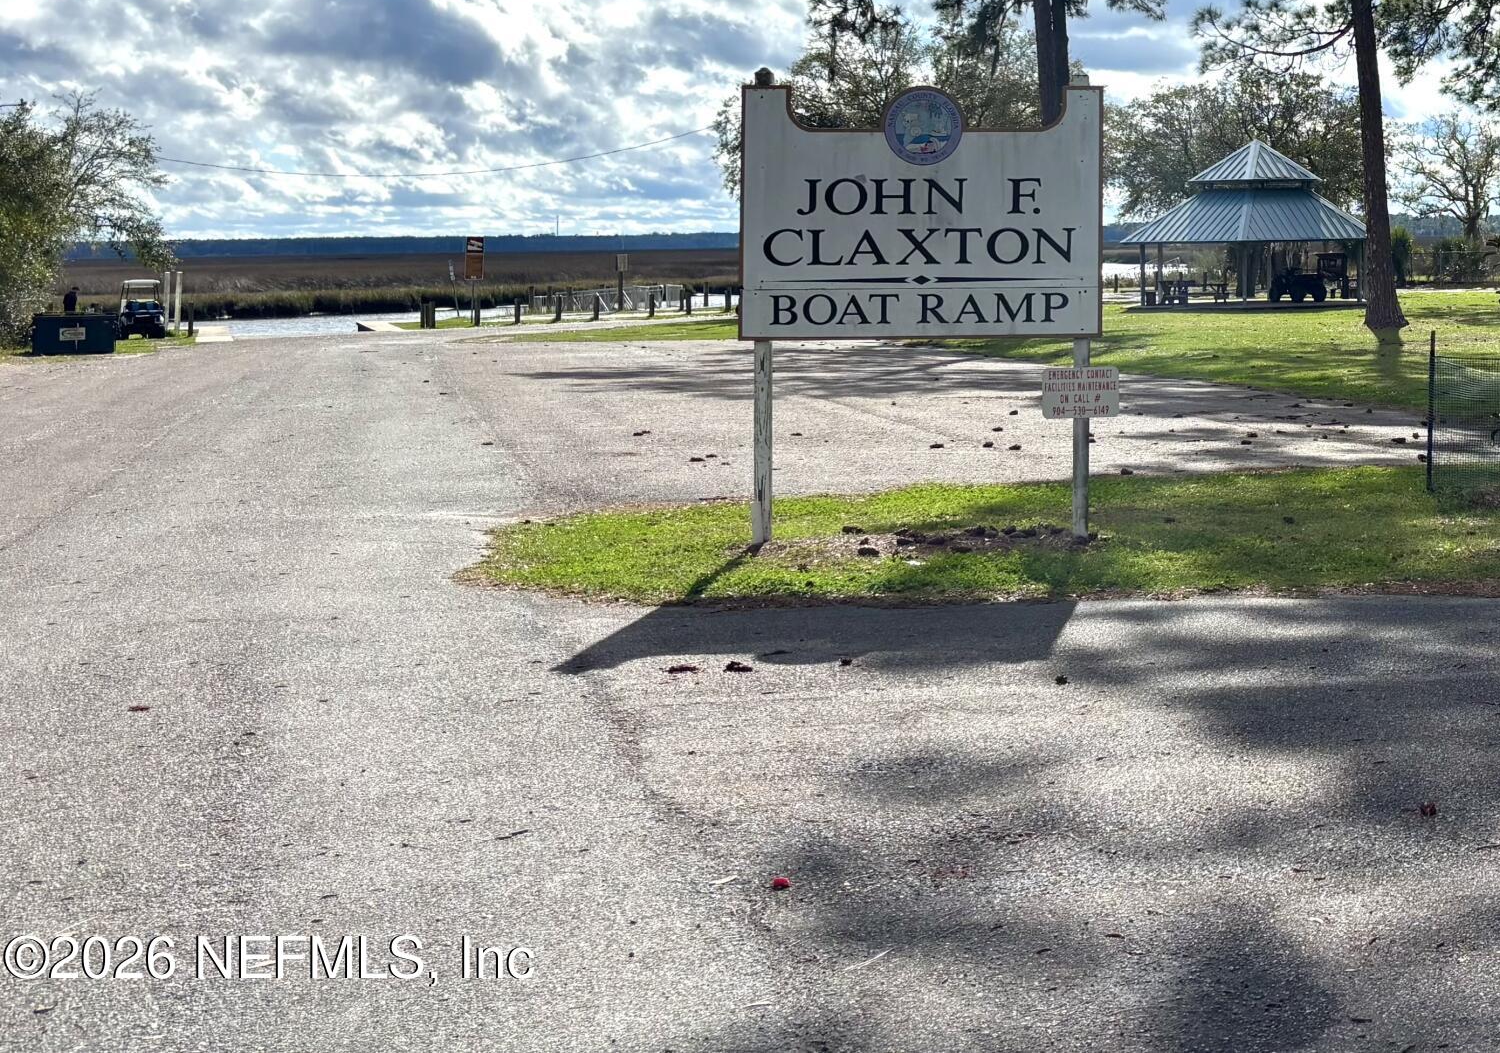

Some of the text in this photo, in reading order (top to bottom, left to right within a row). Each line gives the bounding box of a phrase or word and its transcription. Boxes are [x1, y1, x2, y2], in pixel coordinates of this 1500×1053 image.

[796, 178, 1042, 216] JOHN F.
[763, 227, 1076, 267] CLAXTON
[769, 292, 1070, 326] BOAT RAMP
[1048, 369, 1113, 380] EMERGENCY CONTACT
[1044, 381, 1116, 392] FACILITIES MAINTENANCE
[1060, 393, 1101, 404] ON CALL #
